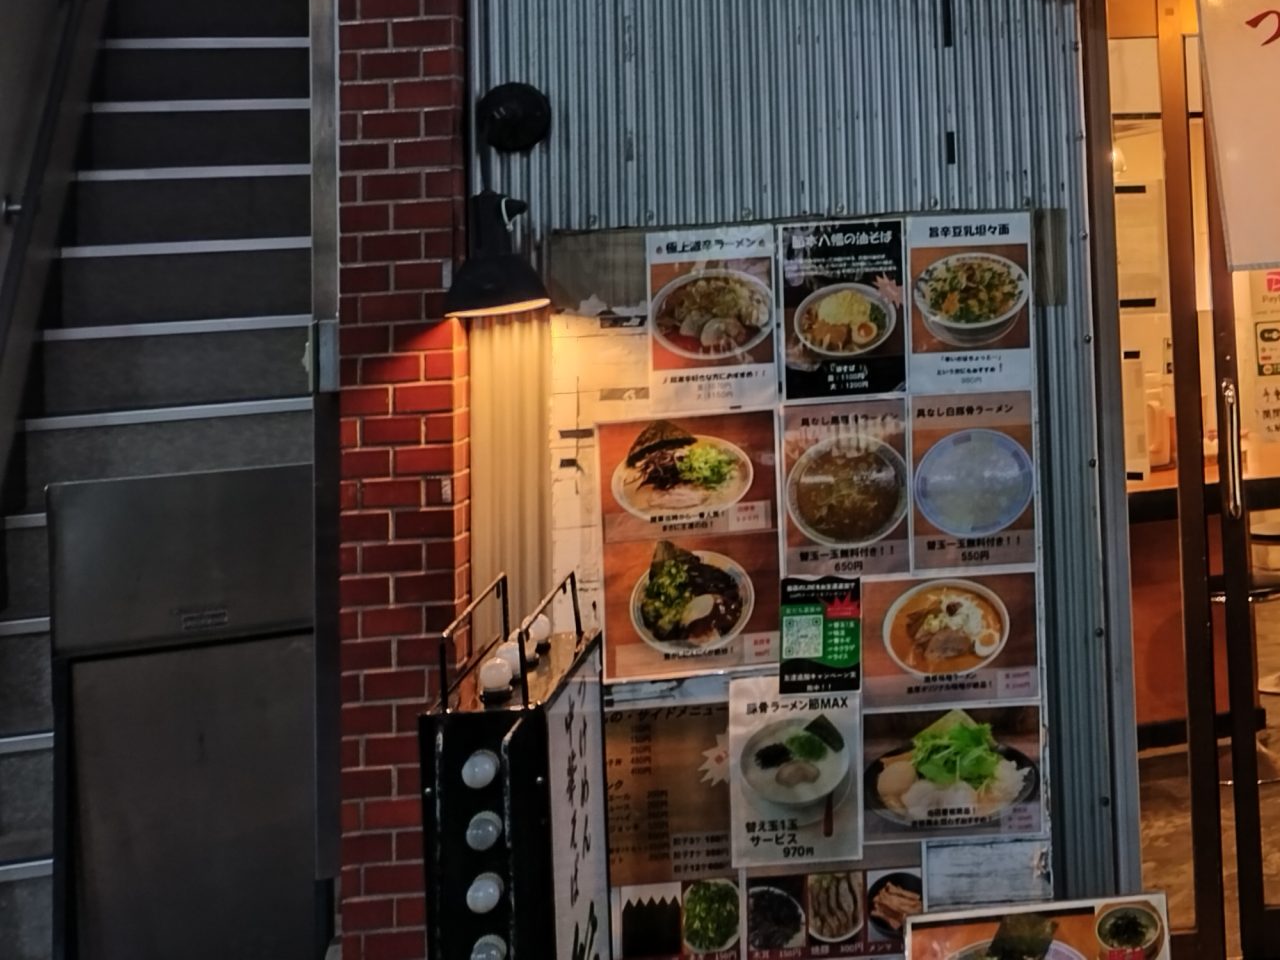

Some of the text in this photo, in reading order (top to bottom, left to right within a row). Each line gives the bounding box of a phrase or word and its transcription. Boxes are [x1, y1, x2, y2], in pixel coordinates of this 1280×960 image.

[834, 561, 864, 572] 650円
[746, 819, 799, 833] 替え玉1玉
[750, 833, 798, 847] サービス
[782, 846, 815, 858] 970円
